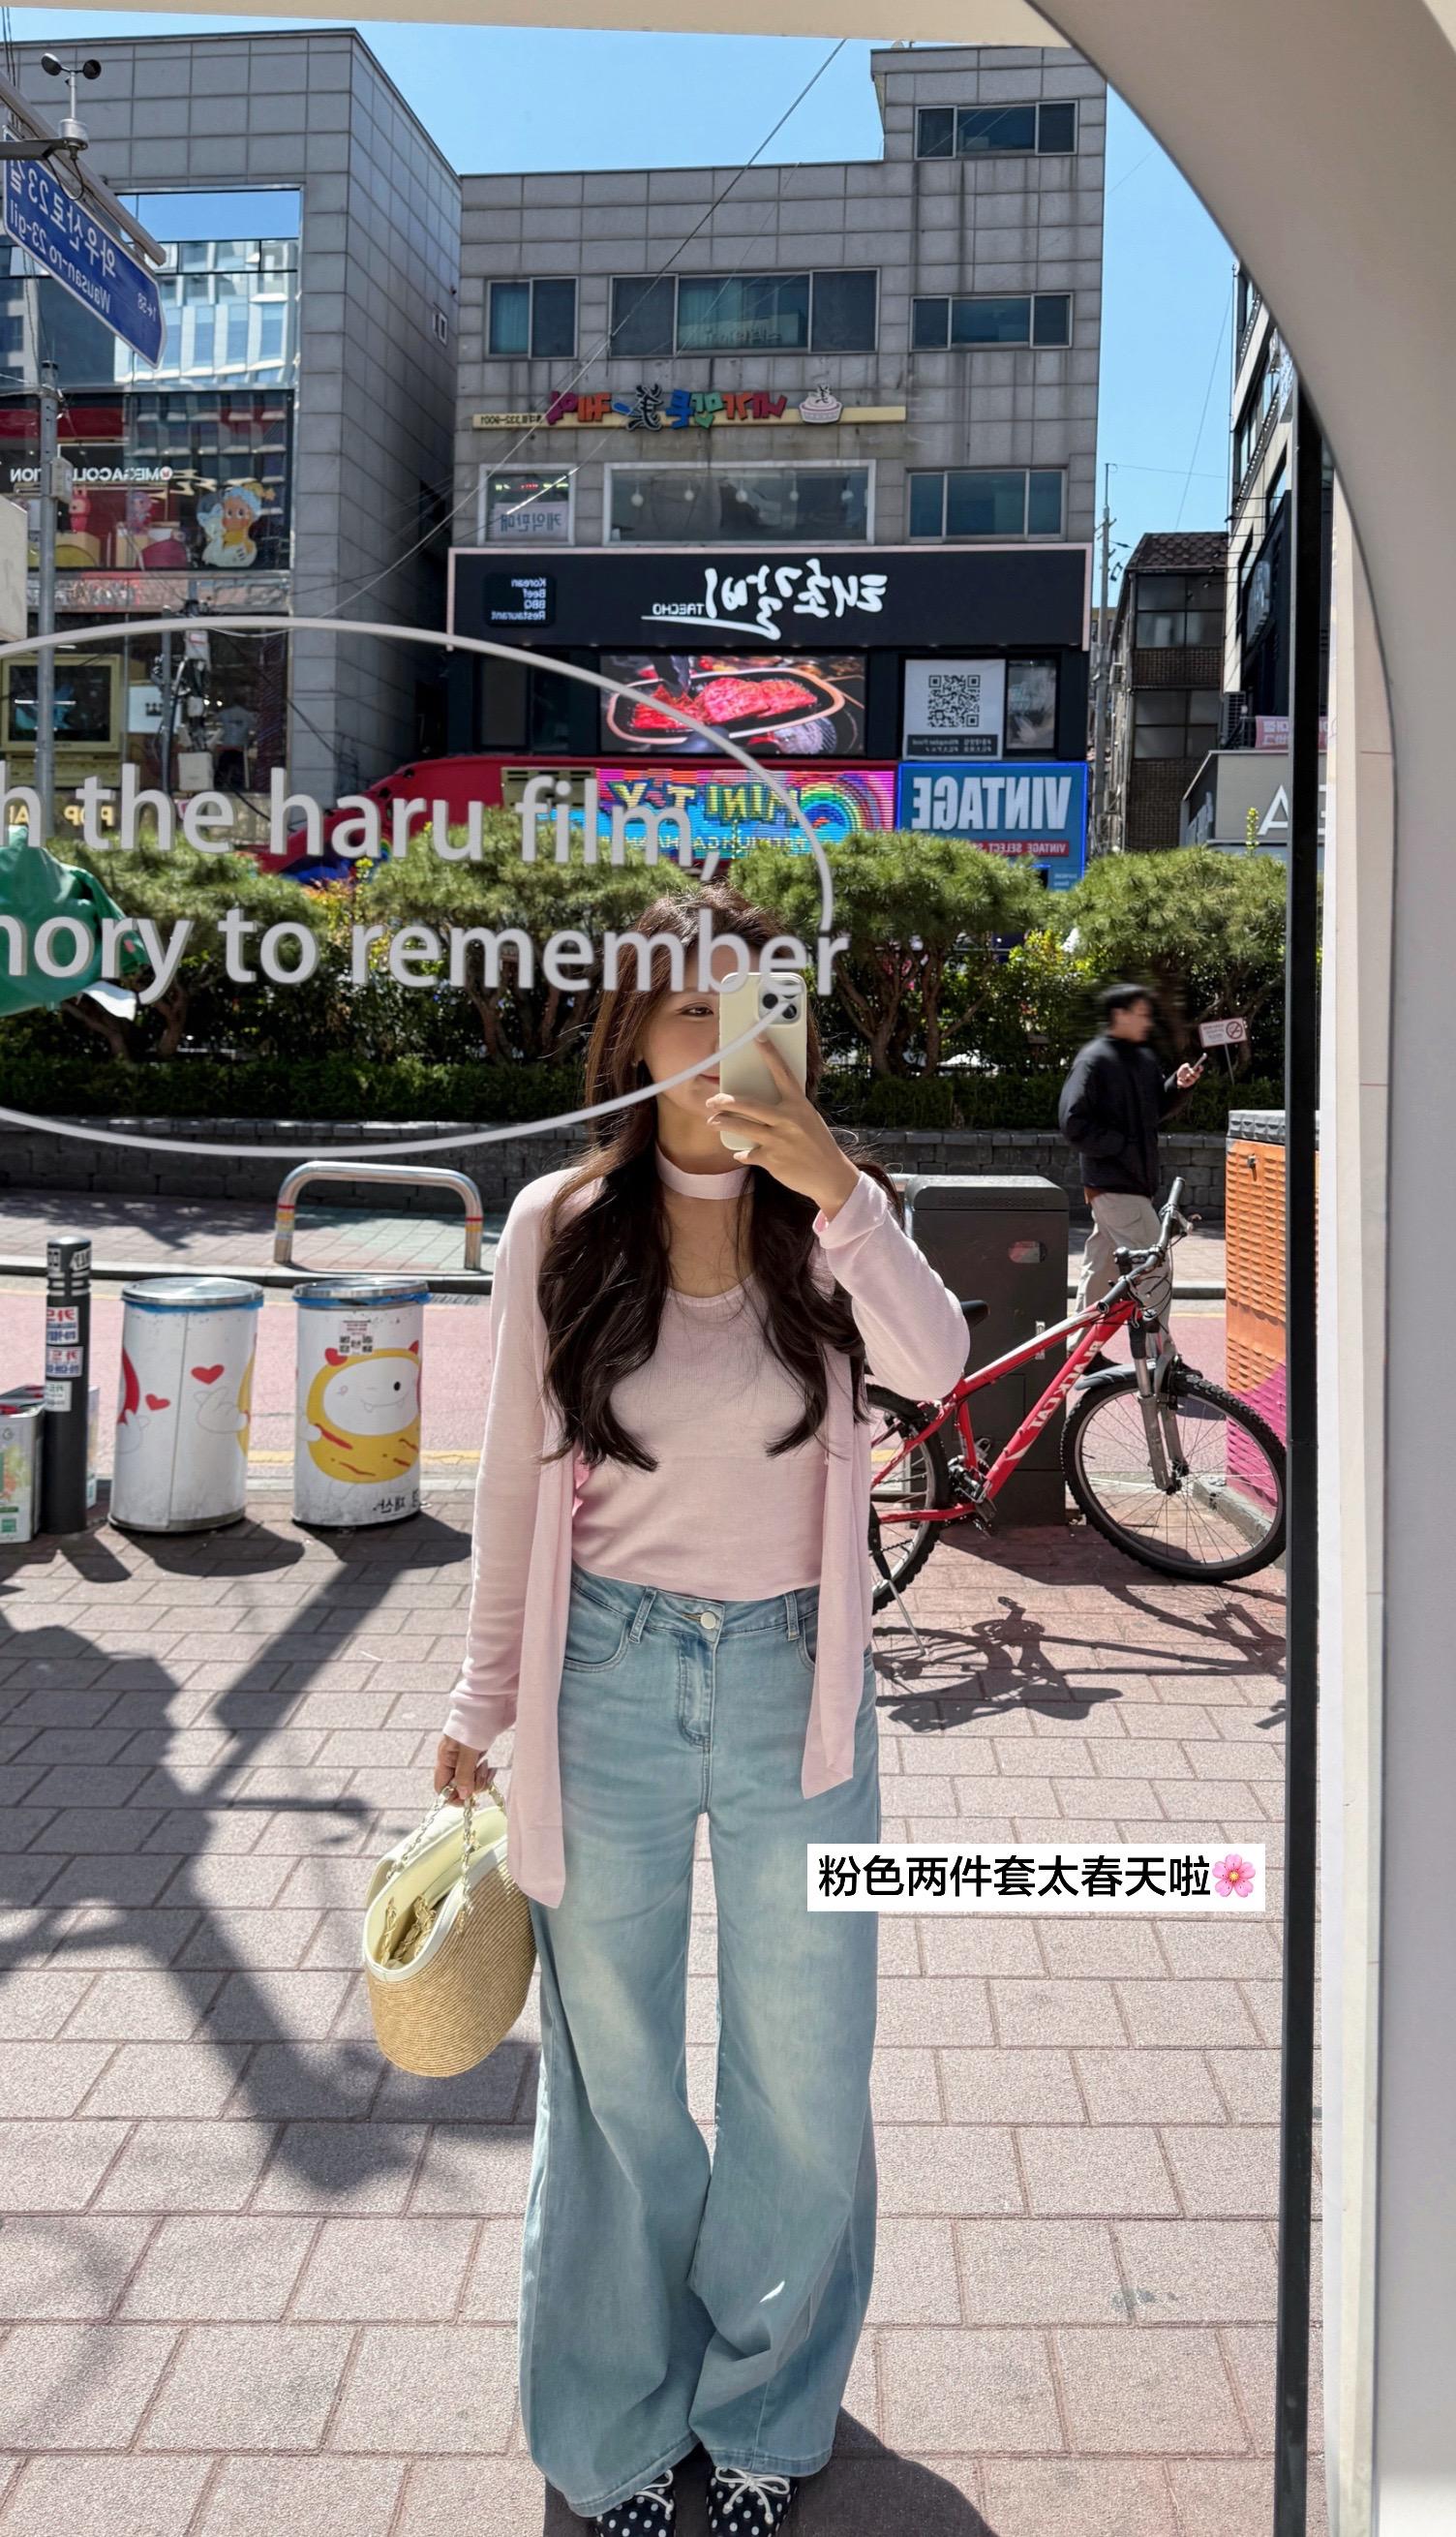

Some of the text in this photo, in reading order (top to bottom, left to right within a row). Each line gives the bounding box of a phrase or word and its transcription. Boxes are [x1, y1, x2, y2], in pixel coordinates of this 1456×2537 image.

[76, 763, 237, 854] the
[270, 766, 483, 861] haru
[515, 775, 720, 882] film,
[217, 906, 320, 986] to
[351, 907, 850, 997] remember
